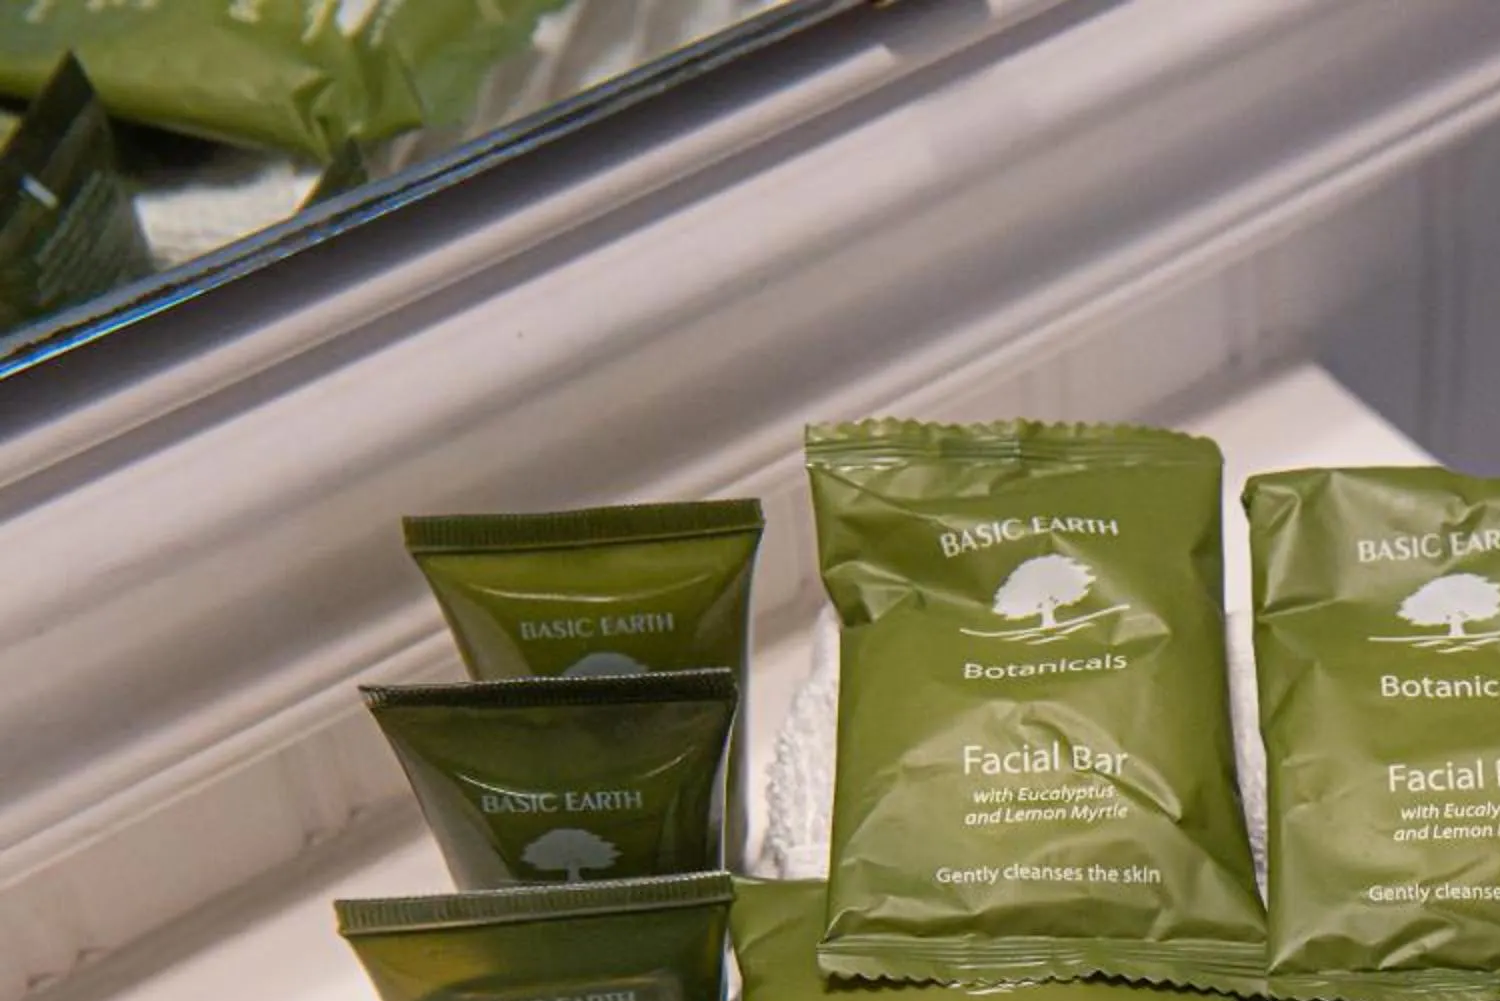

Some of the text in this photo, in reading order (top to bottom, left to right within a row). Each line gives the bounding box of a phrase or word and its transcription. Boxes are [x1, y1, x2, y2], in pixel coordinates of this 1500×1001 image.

[940, 516, 1119, 559] BASIC EARTH
[1357, 535, 1442, 563] BASIC
[520, 612, 675, 642] BASIC EARTH
[963, 654, 1128, 680] Botanicals
[963, 741, 1128, 777] Facial Bar
[1388, 761, 1485, 793] Facial
[481, 790, 643, 814] BASIC EARTH
[973, 783, 1115, 806] with Eucalyptus
[964, 804, 1128, 826] and Lemon Myrtle
[1401, 804, 1440, 820] with
[1394, 823, 1430, 841] and
[1433, 823, 1493, 840] Lemon
[936, 864, 1161, 887] Gently cleanses the skin
[1369, 885, 1431, 905] Gently
